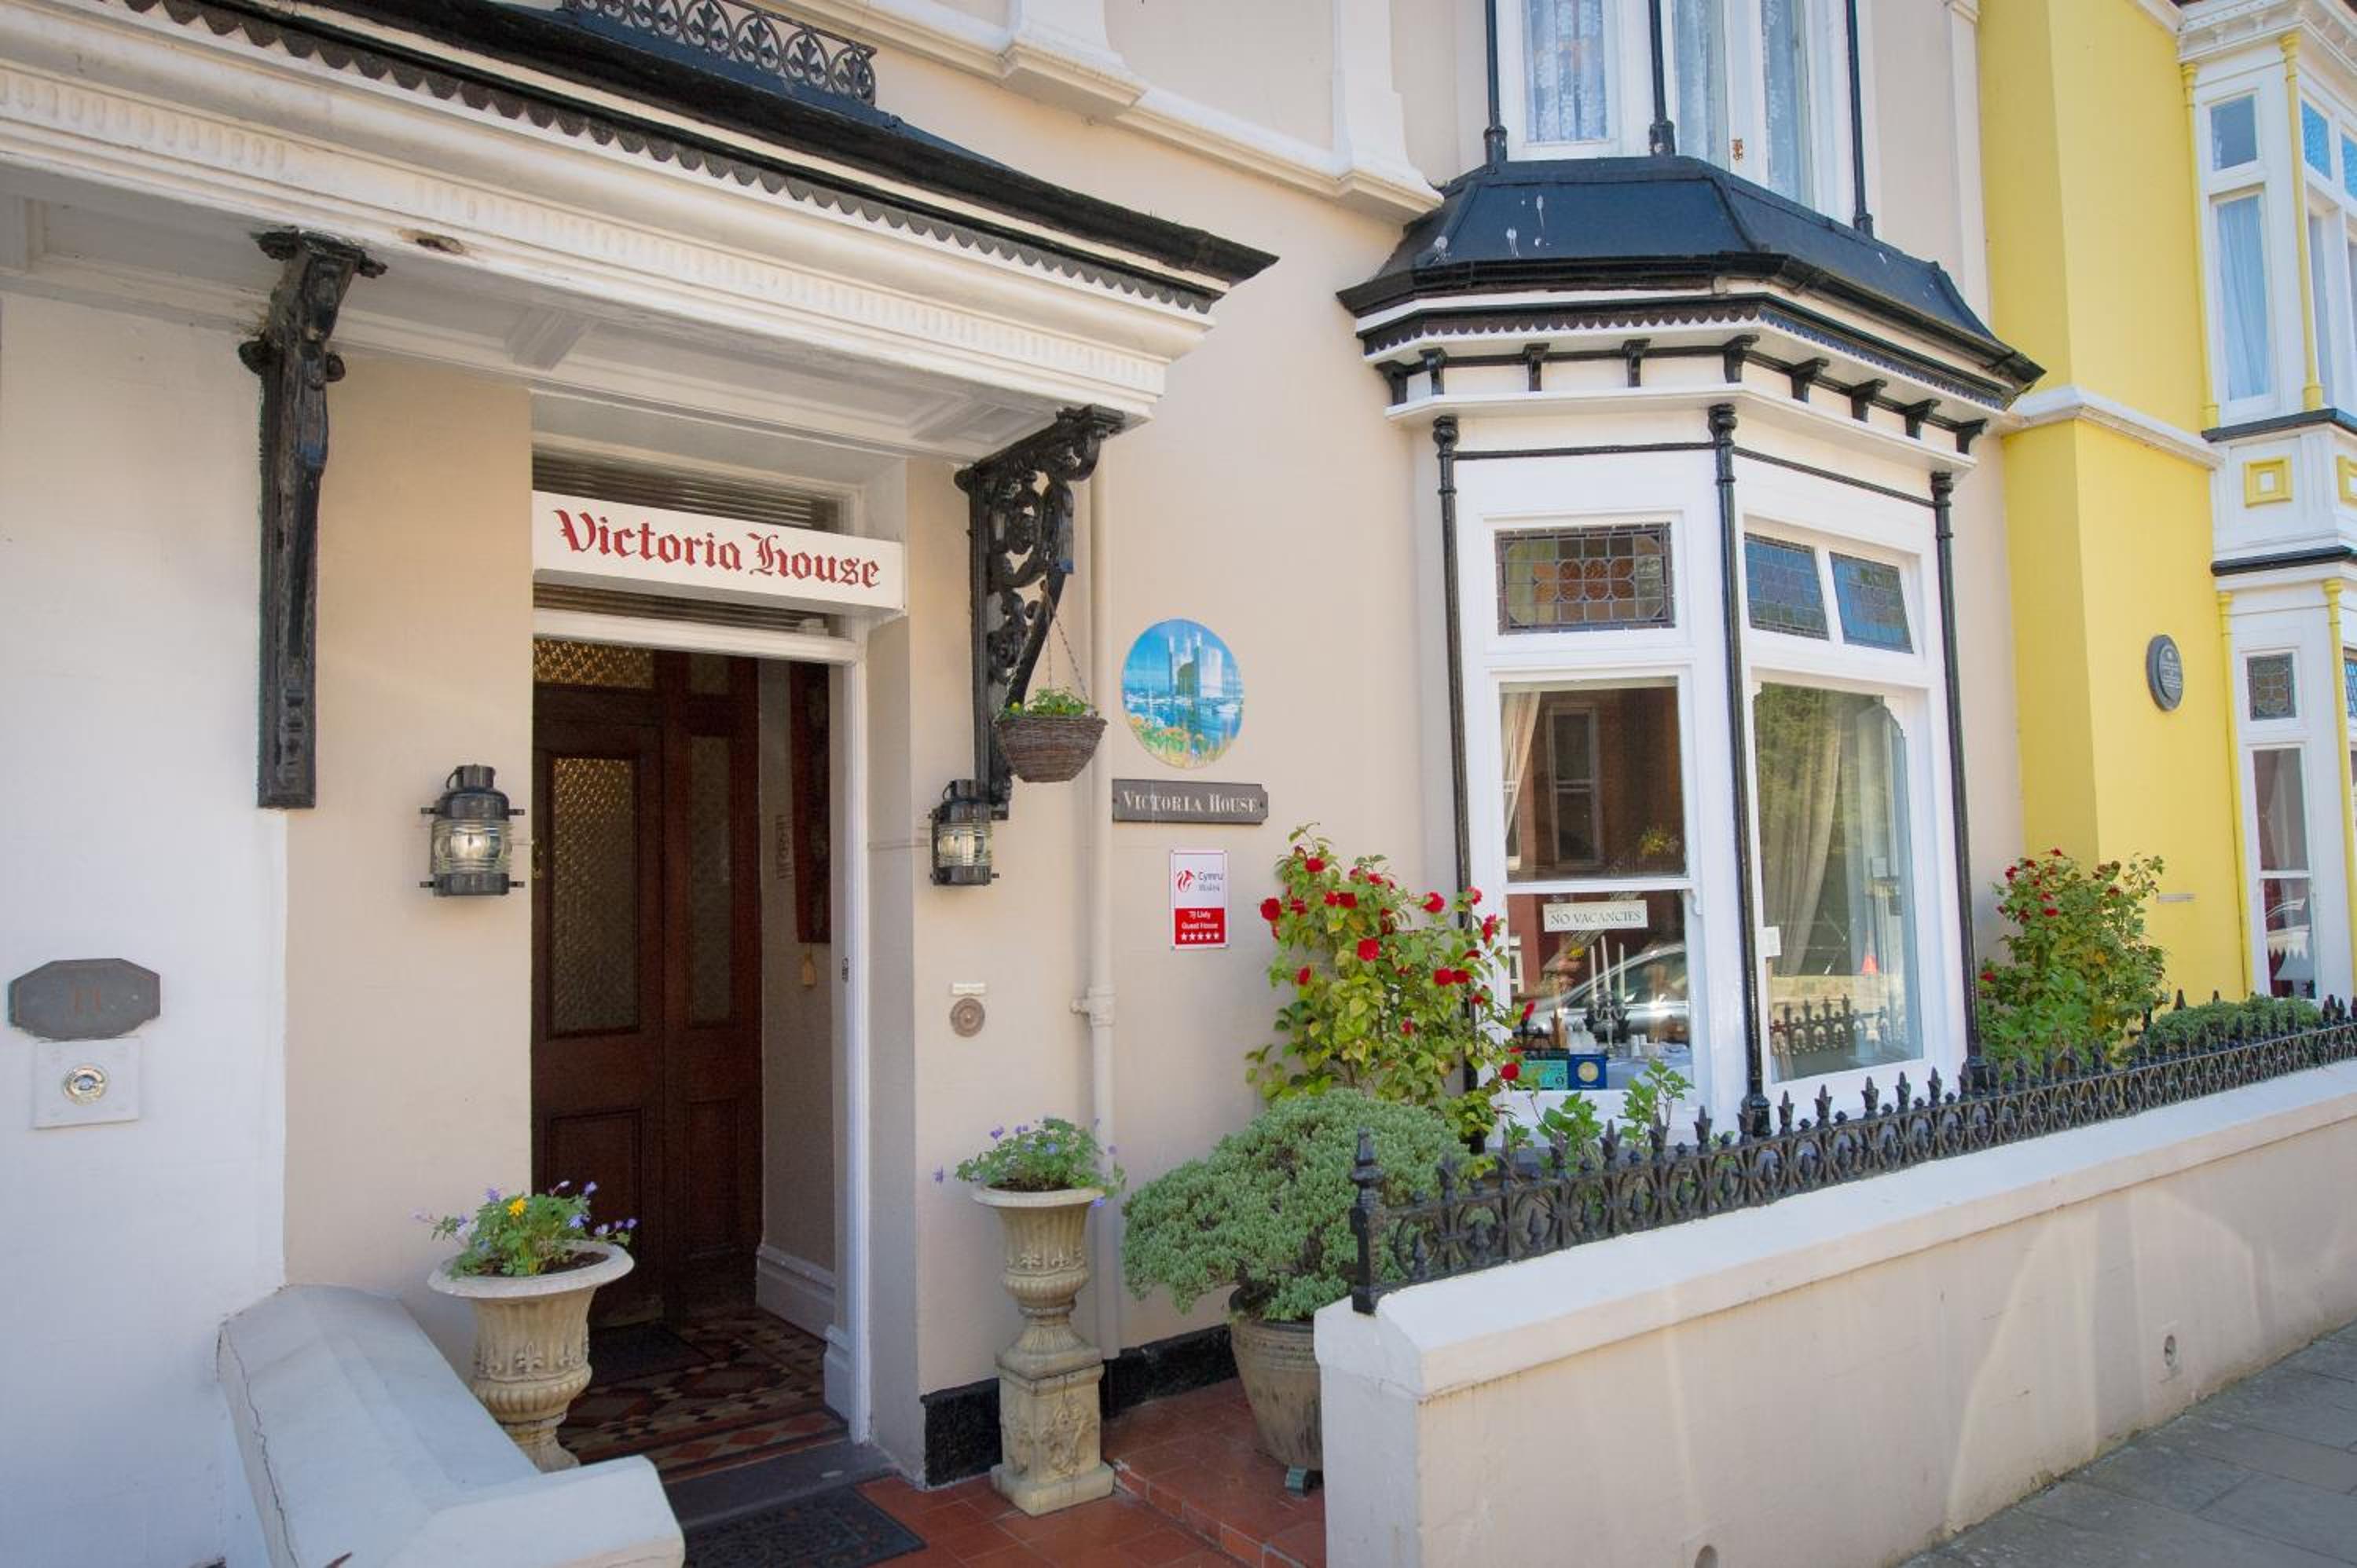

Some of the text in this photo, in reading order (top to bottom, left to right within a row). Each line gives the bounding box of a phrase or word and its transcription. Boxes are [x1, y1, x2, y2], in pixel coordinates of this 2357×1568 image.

[552, 510, 742, 571] Victoria
[1124, 791, 1257, 813] VICTORIA HOUSE
[1198, 871, 1223, 881] Cymru
[1550, 910, 1642, 925] NO VACANCIES
